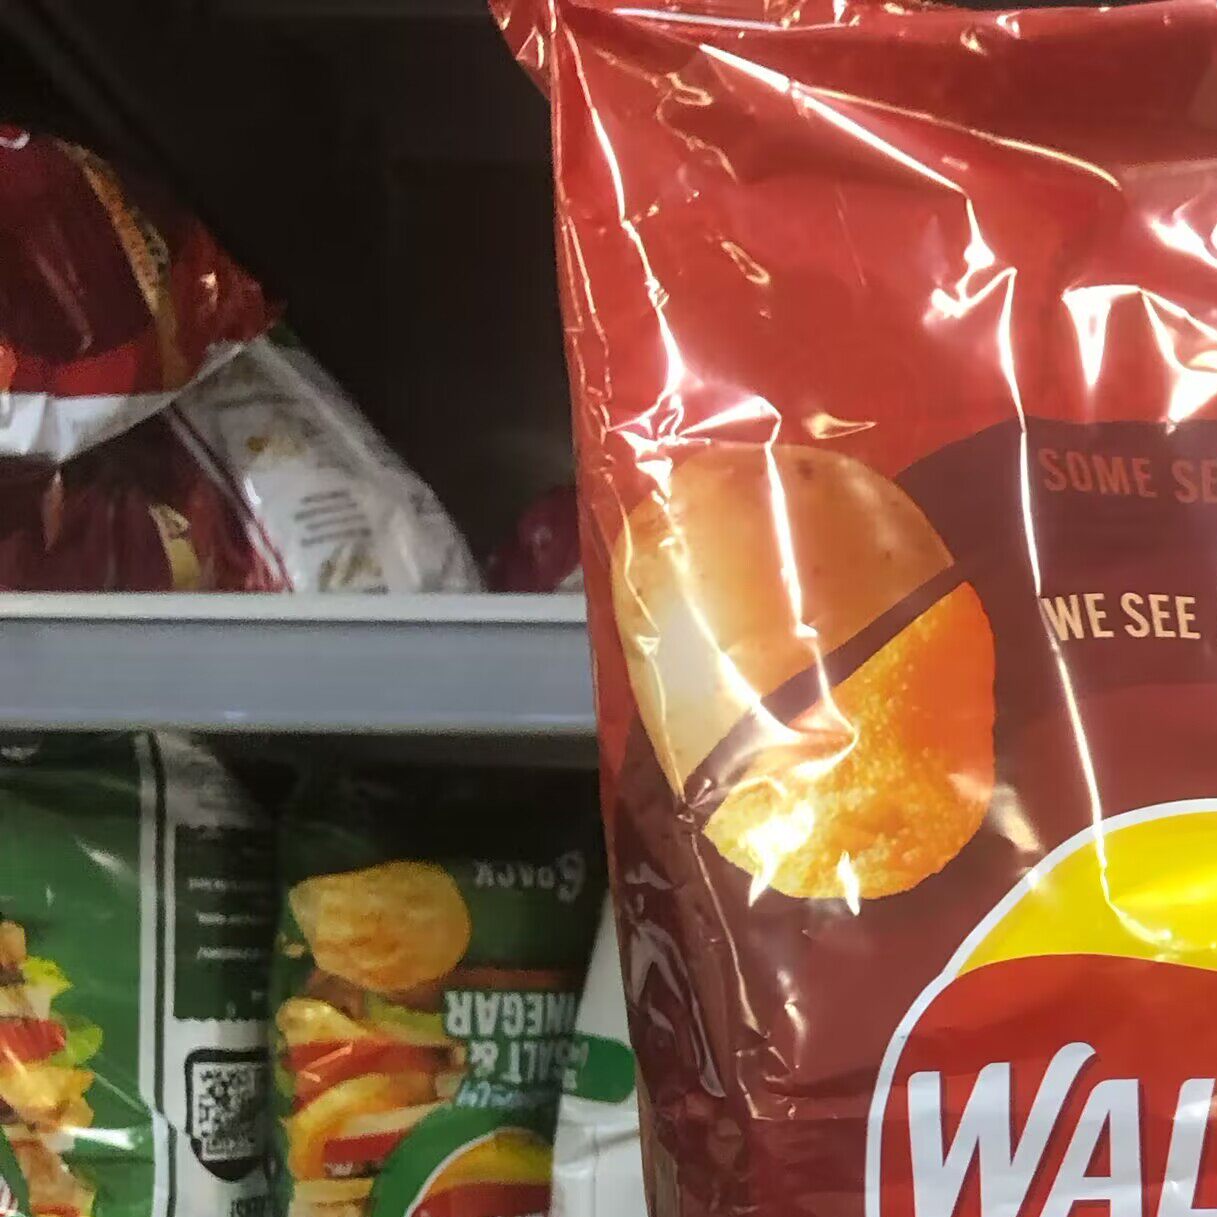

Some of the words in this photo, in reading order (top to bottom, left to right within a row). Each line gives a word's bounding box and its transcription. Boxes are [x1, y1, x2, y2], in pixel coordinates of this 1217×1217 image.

[1038, 448, 1160, 498] SOME
[1040, 593, 1115, 641] WE
[1122, 592, 1201, 640] SEE
